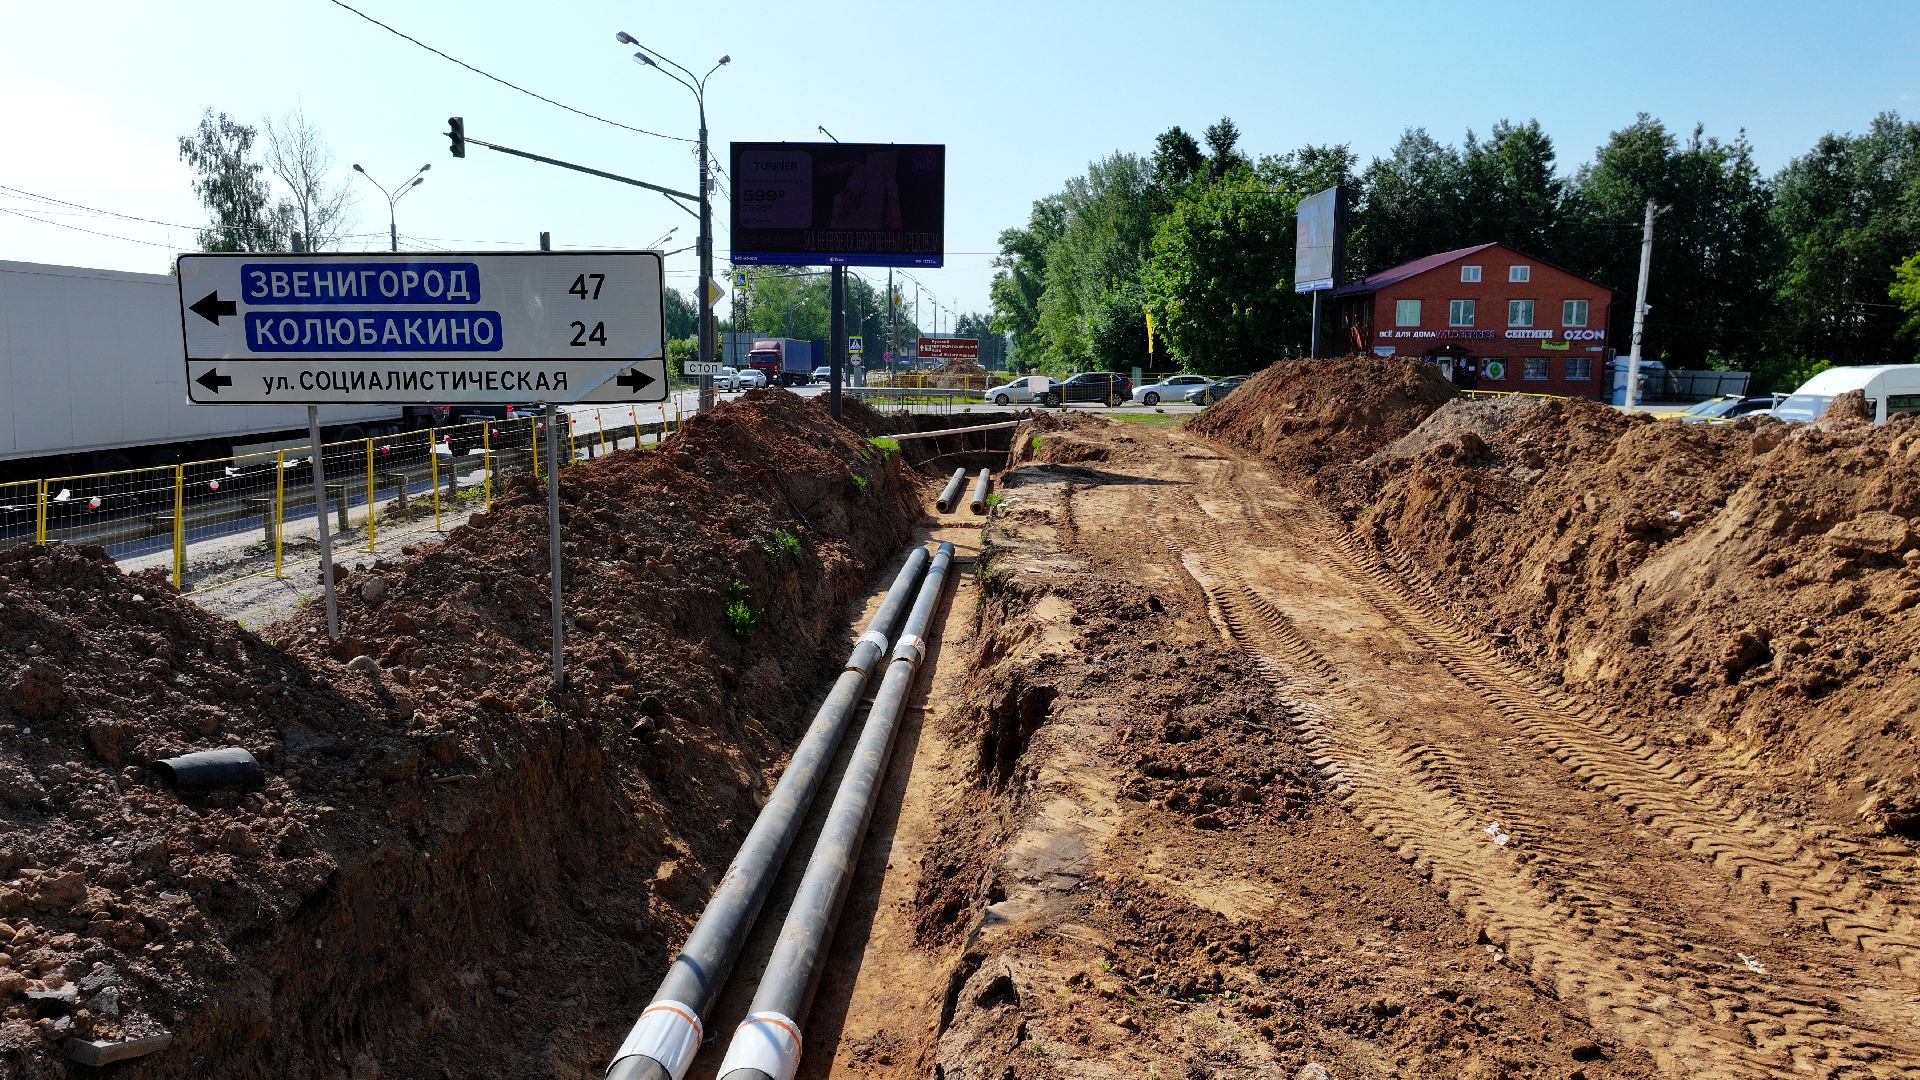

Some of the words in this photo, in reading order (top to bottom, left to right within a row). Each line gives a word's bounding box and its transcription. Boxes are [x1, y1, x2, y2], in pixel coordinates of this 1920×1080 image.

[250, 269, 470, 301] ЗВЕНИГОРОД
[568, 273, 606, 301] 47
[255, 317, 494, 346] КОЛЮБАКИНО
[569, 320, 608, 347] 24
[1394, 330, 1411, 338] ДЛЯ
[1412, 330, 1436, 338] ДОМА
[1504, 329, 1553, 339] СЕПТИКИ
[1563, 329, 1605, 341] OZON
[689, 364, 718, 373] СТОП
[299, 370, 568, 394] СОЦИАЛИСТИЧЕСКАЯ
